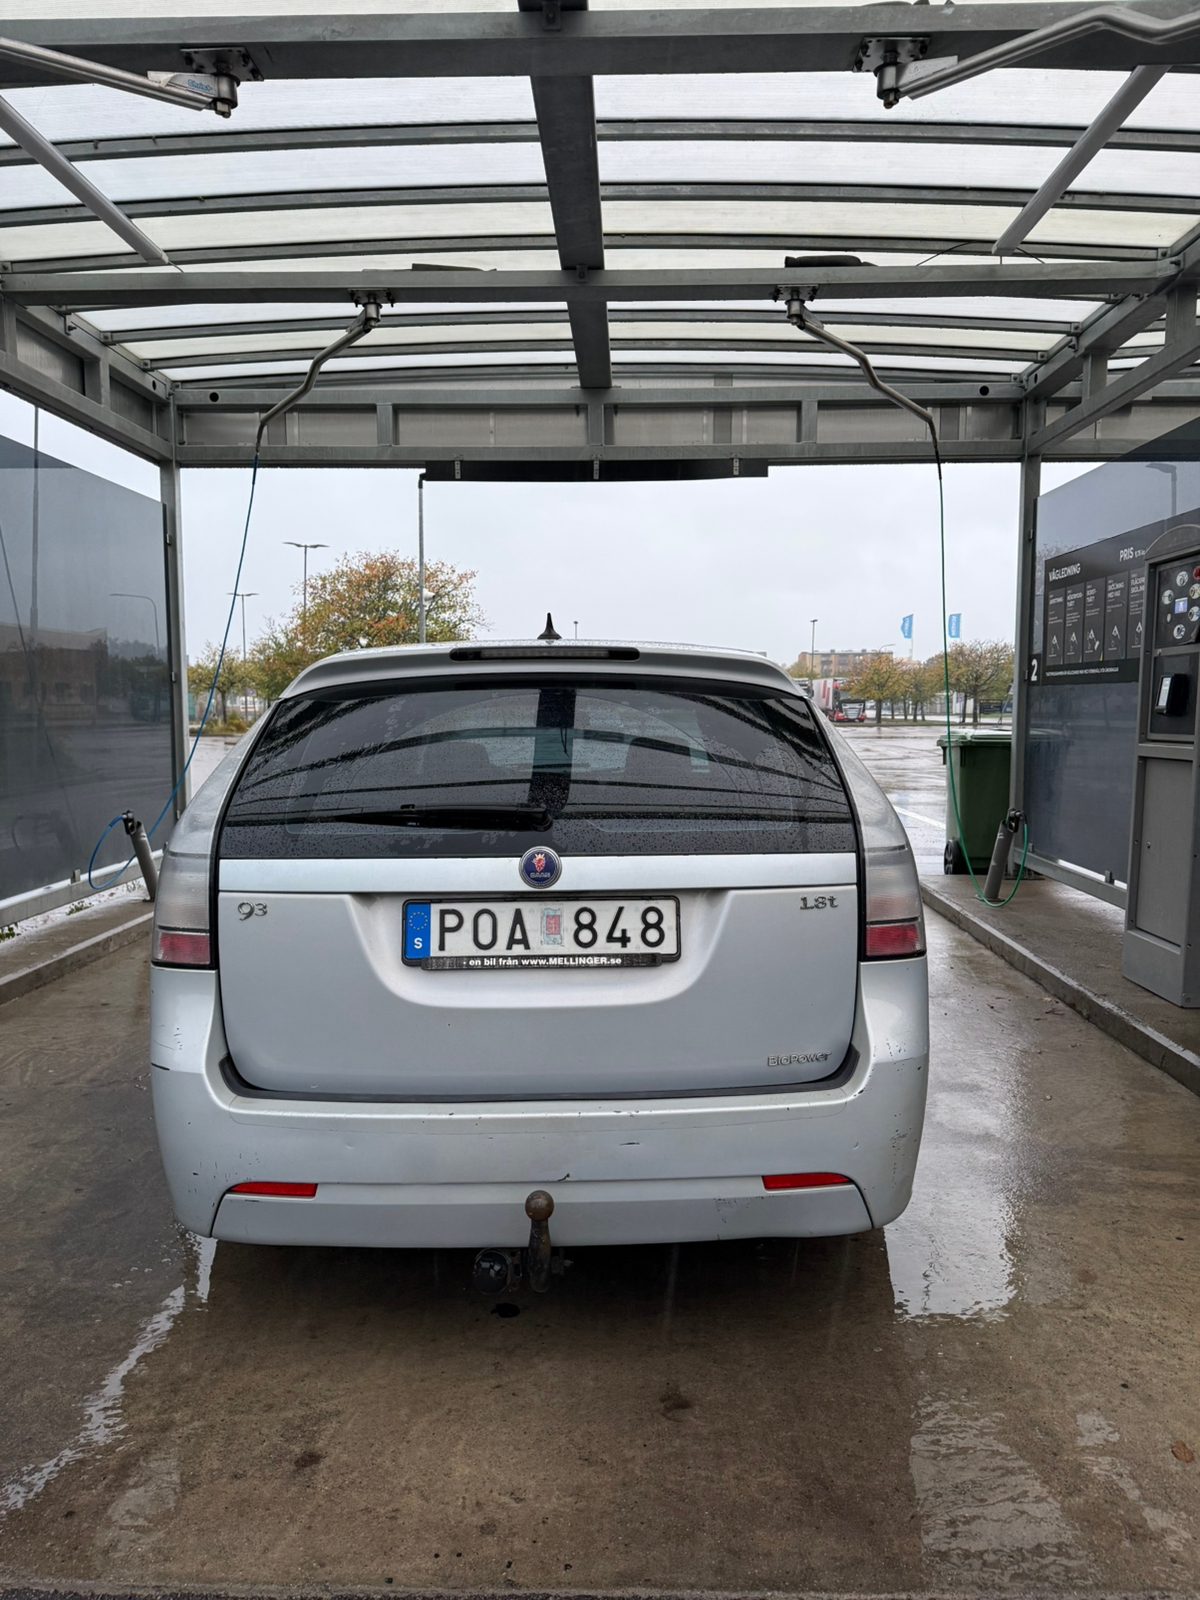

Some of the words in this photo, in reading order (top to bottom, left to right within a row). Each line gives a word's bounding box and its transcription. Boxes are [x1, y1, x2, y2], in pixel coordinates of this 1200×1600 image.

[1119, 546, 1134, 562] PRIS
[1030, 658, 1038, 682] 2
[237, 901, 268, 921] 93
[438, 908, 531, 951] POA
[573, 905, 666, 949] 848
[413, 937, 423, 949] S
[484, 957, 496, 966] bil
[499, 956, 519, 966] från
[521, 956, 622, 966] www.MELLINGER.se
